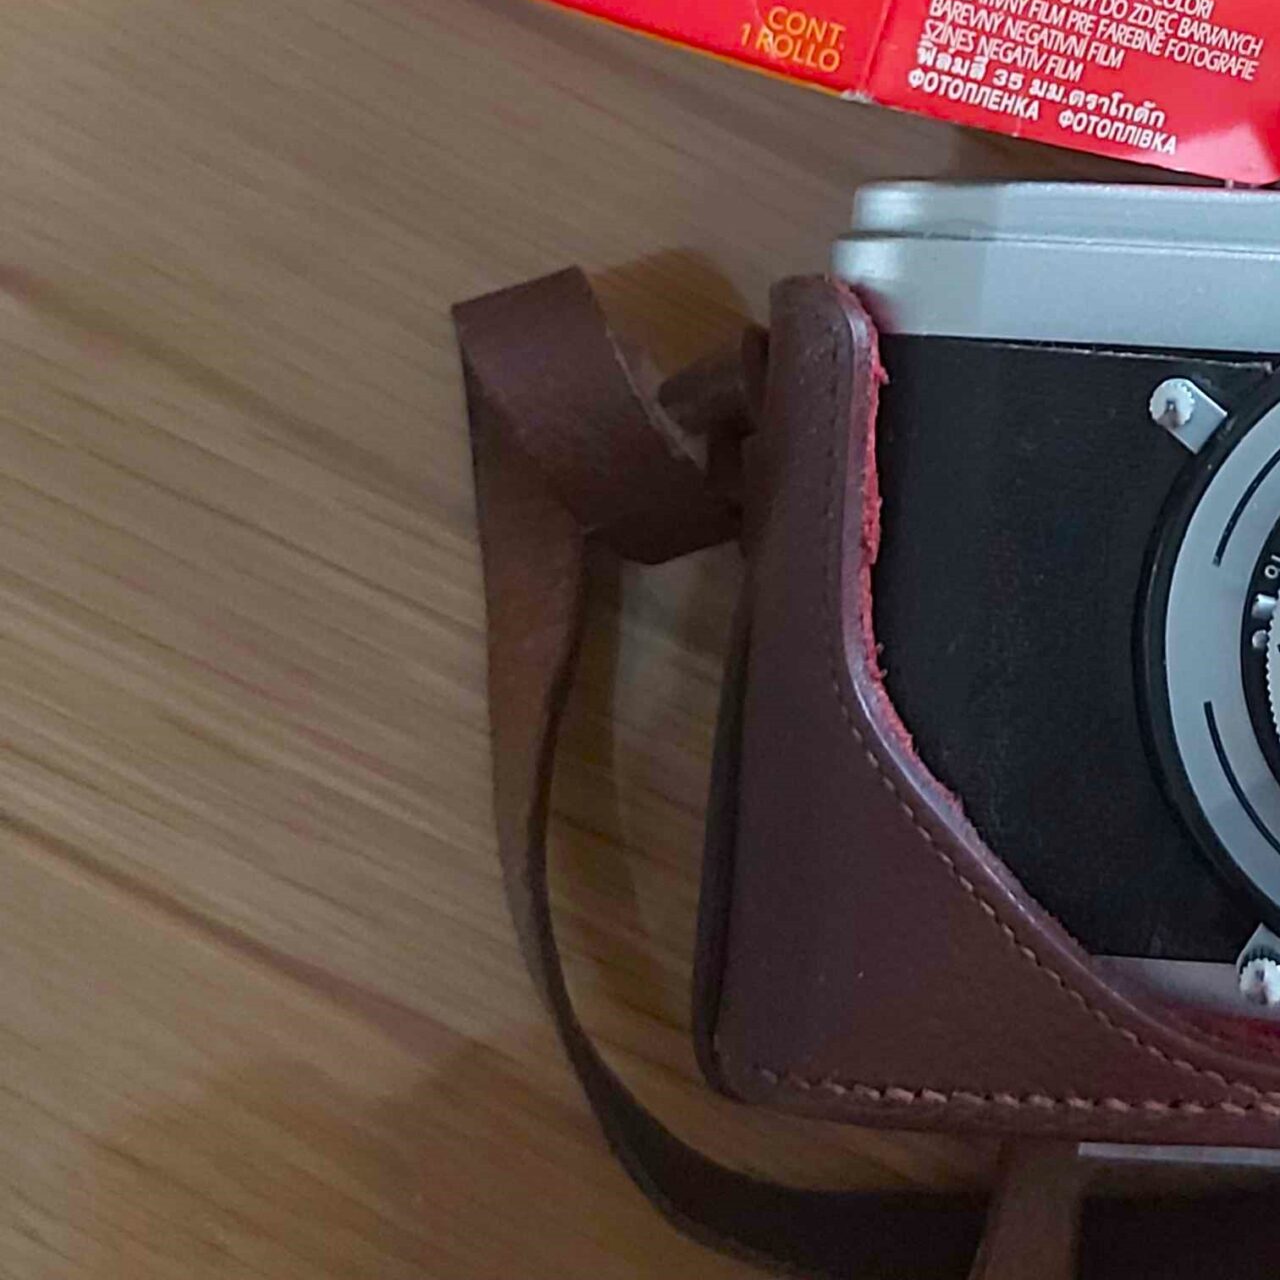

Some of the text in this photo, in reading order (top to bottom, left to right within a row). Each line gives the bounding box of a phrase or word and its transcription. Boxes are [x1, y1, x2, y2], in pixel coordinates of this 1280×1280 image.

[740, 22, 840, 73] 1 ROLLO
[768, 5, 846, 51] CONT.
[1066, 10, 1095, 36] PRE
[1164, 38, 1260, 81] FOTOGRAFIE
[1178, 17, 1264, 59] BARWNYCH
[1045, 55, 1084, 82] FILM
[1087, 41, 1125, 69] FILM
[993, 69, 1025, 91] 35
[907, 67, 1178, 156] ФОТОПЛЕНКА ФОТОПЛІВКА
